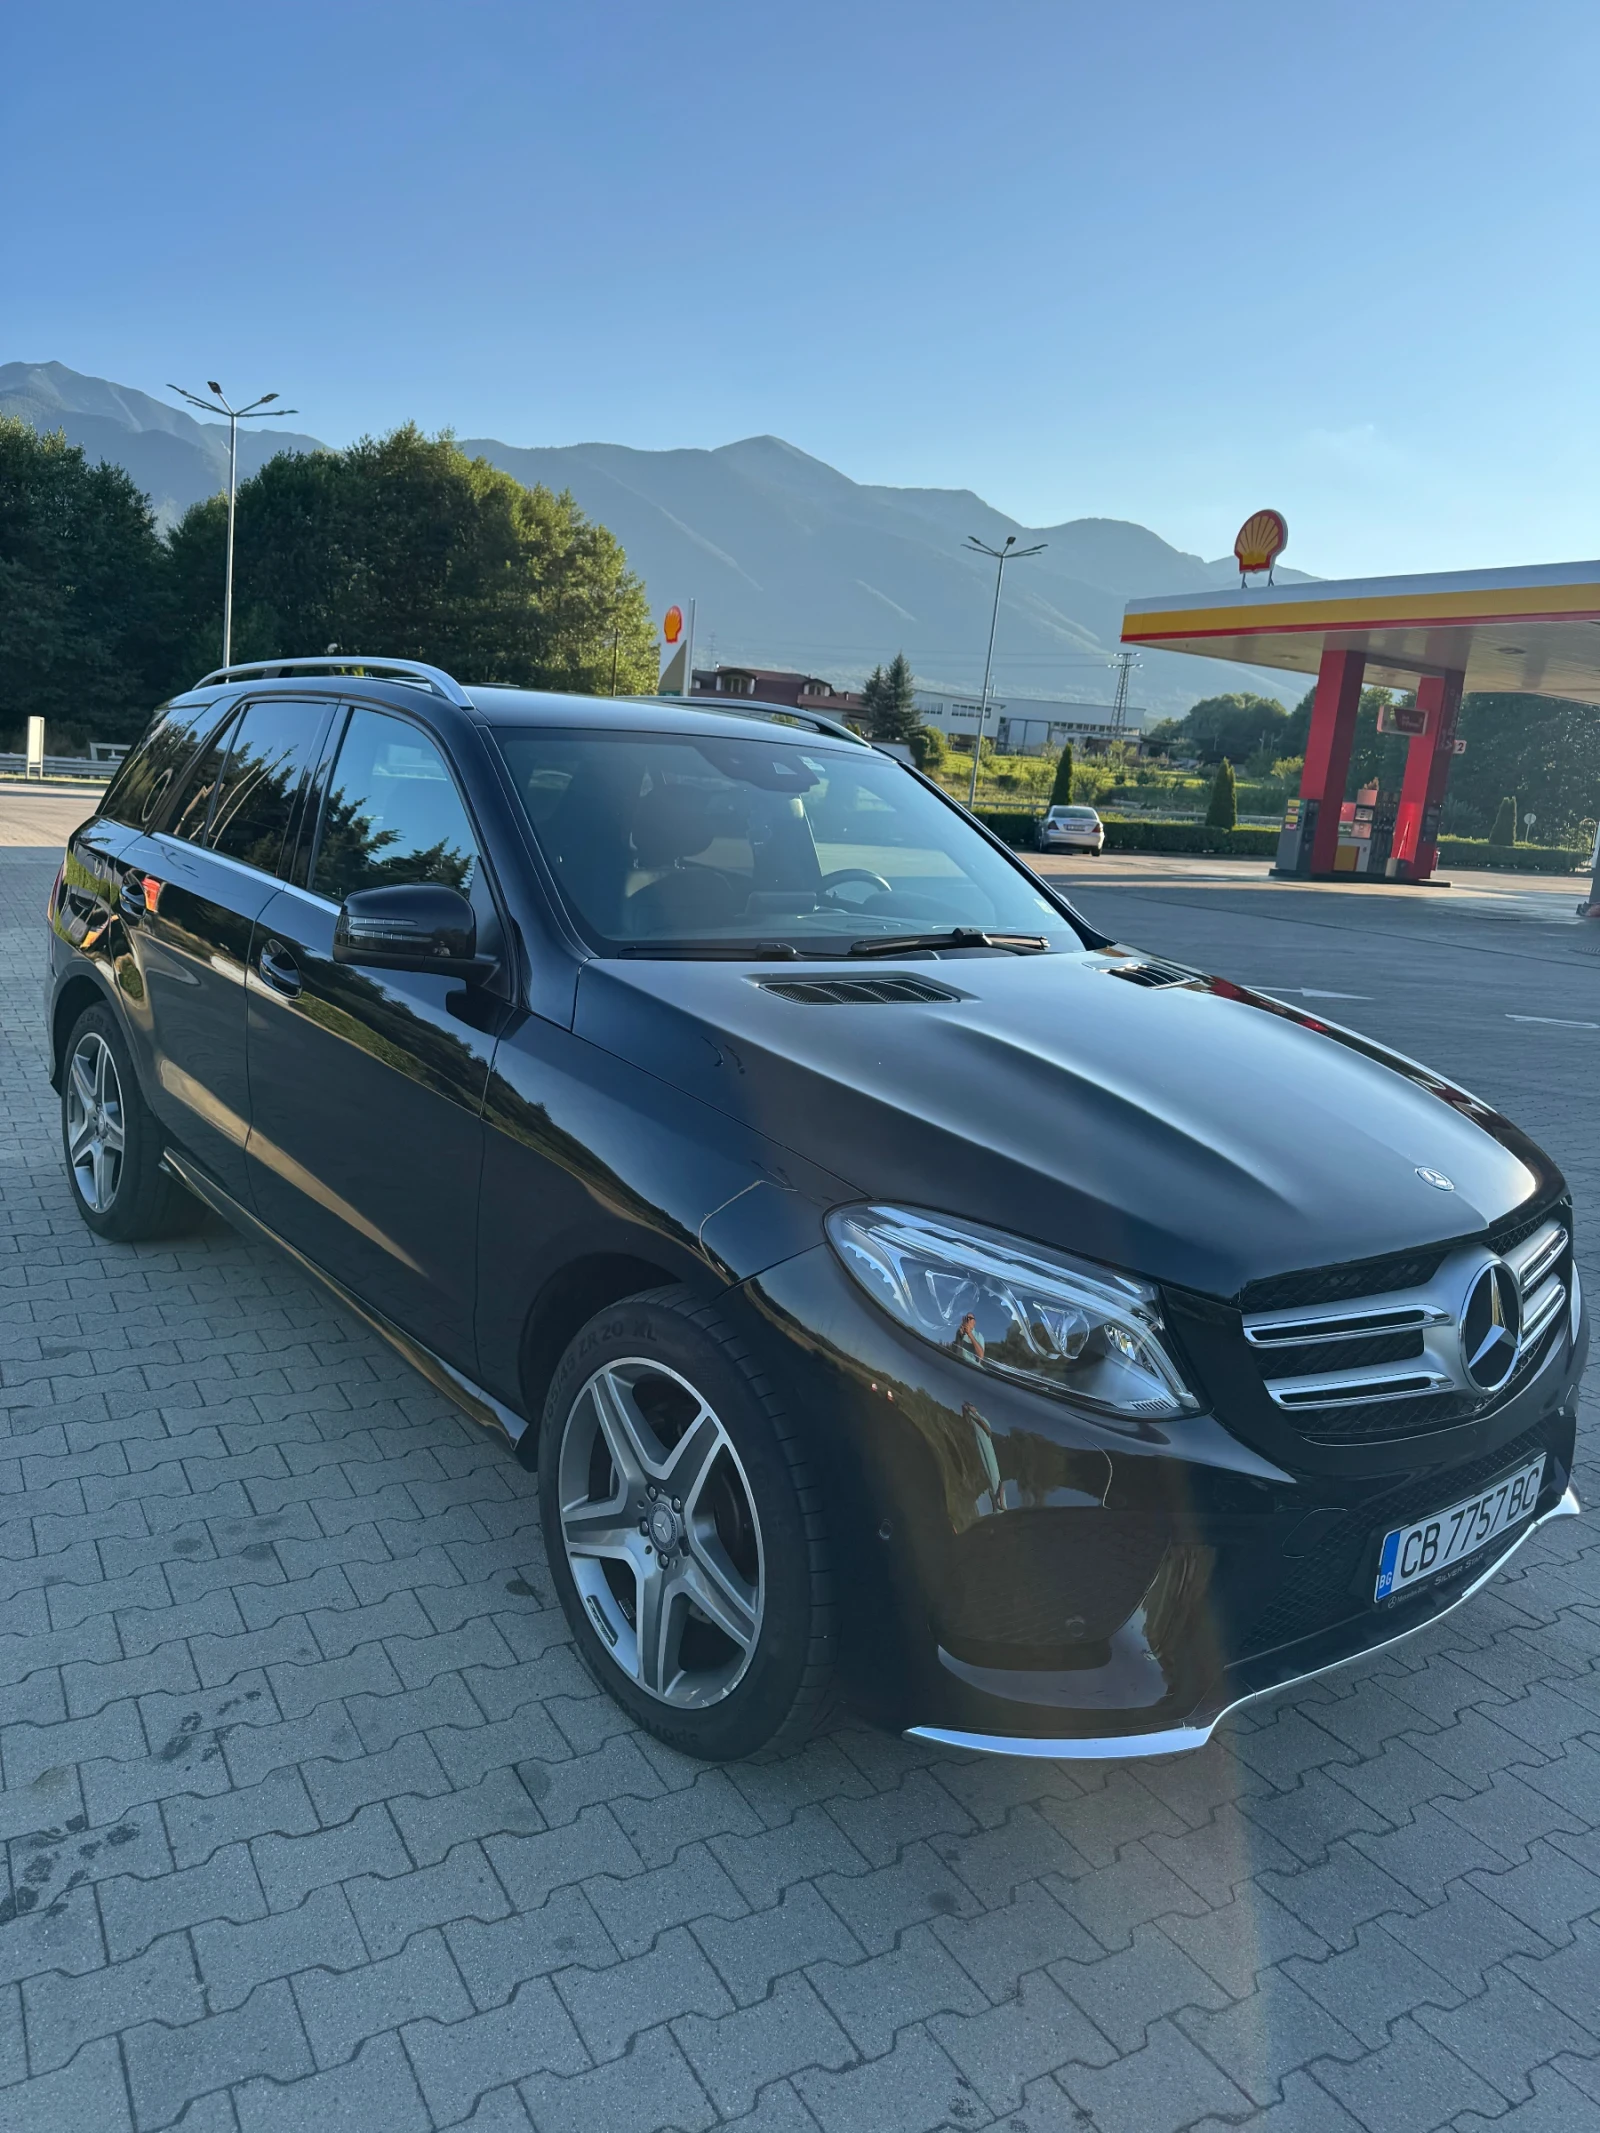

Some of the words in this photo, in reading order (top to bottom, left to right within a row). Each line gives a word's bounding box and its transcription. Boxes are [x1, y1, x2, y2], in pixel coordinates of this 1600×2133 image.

[1457, 743, 1464, 752] 2
[601, 1320, 624, 1341] 20
[632, 1320, 657, 1342] XL
[1400, 1522, 1441, 1579] CB
[1443, 1484, 1509, 1561] 7757
[1505, 1466, 1540, 1521] BC
[1379, 1571, 1392, 1590] BG
